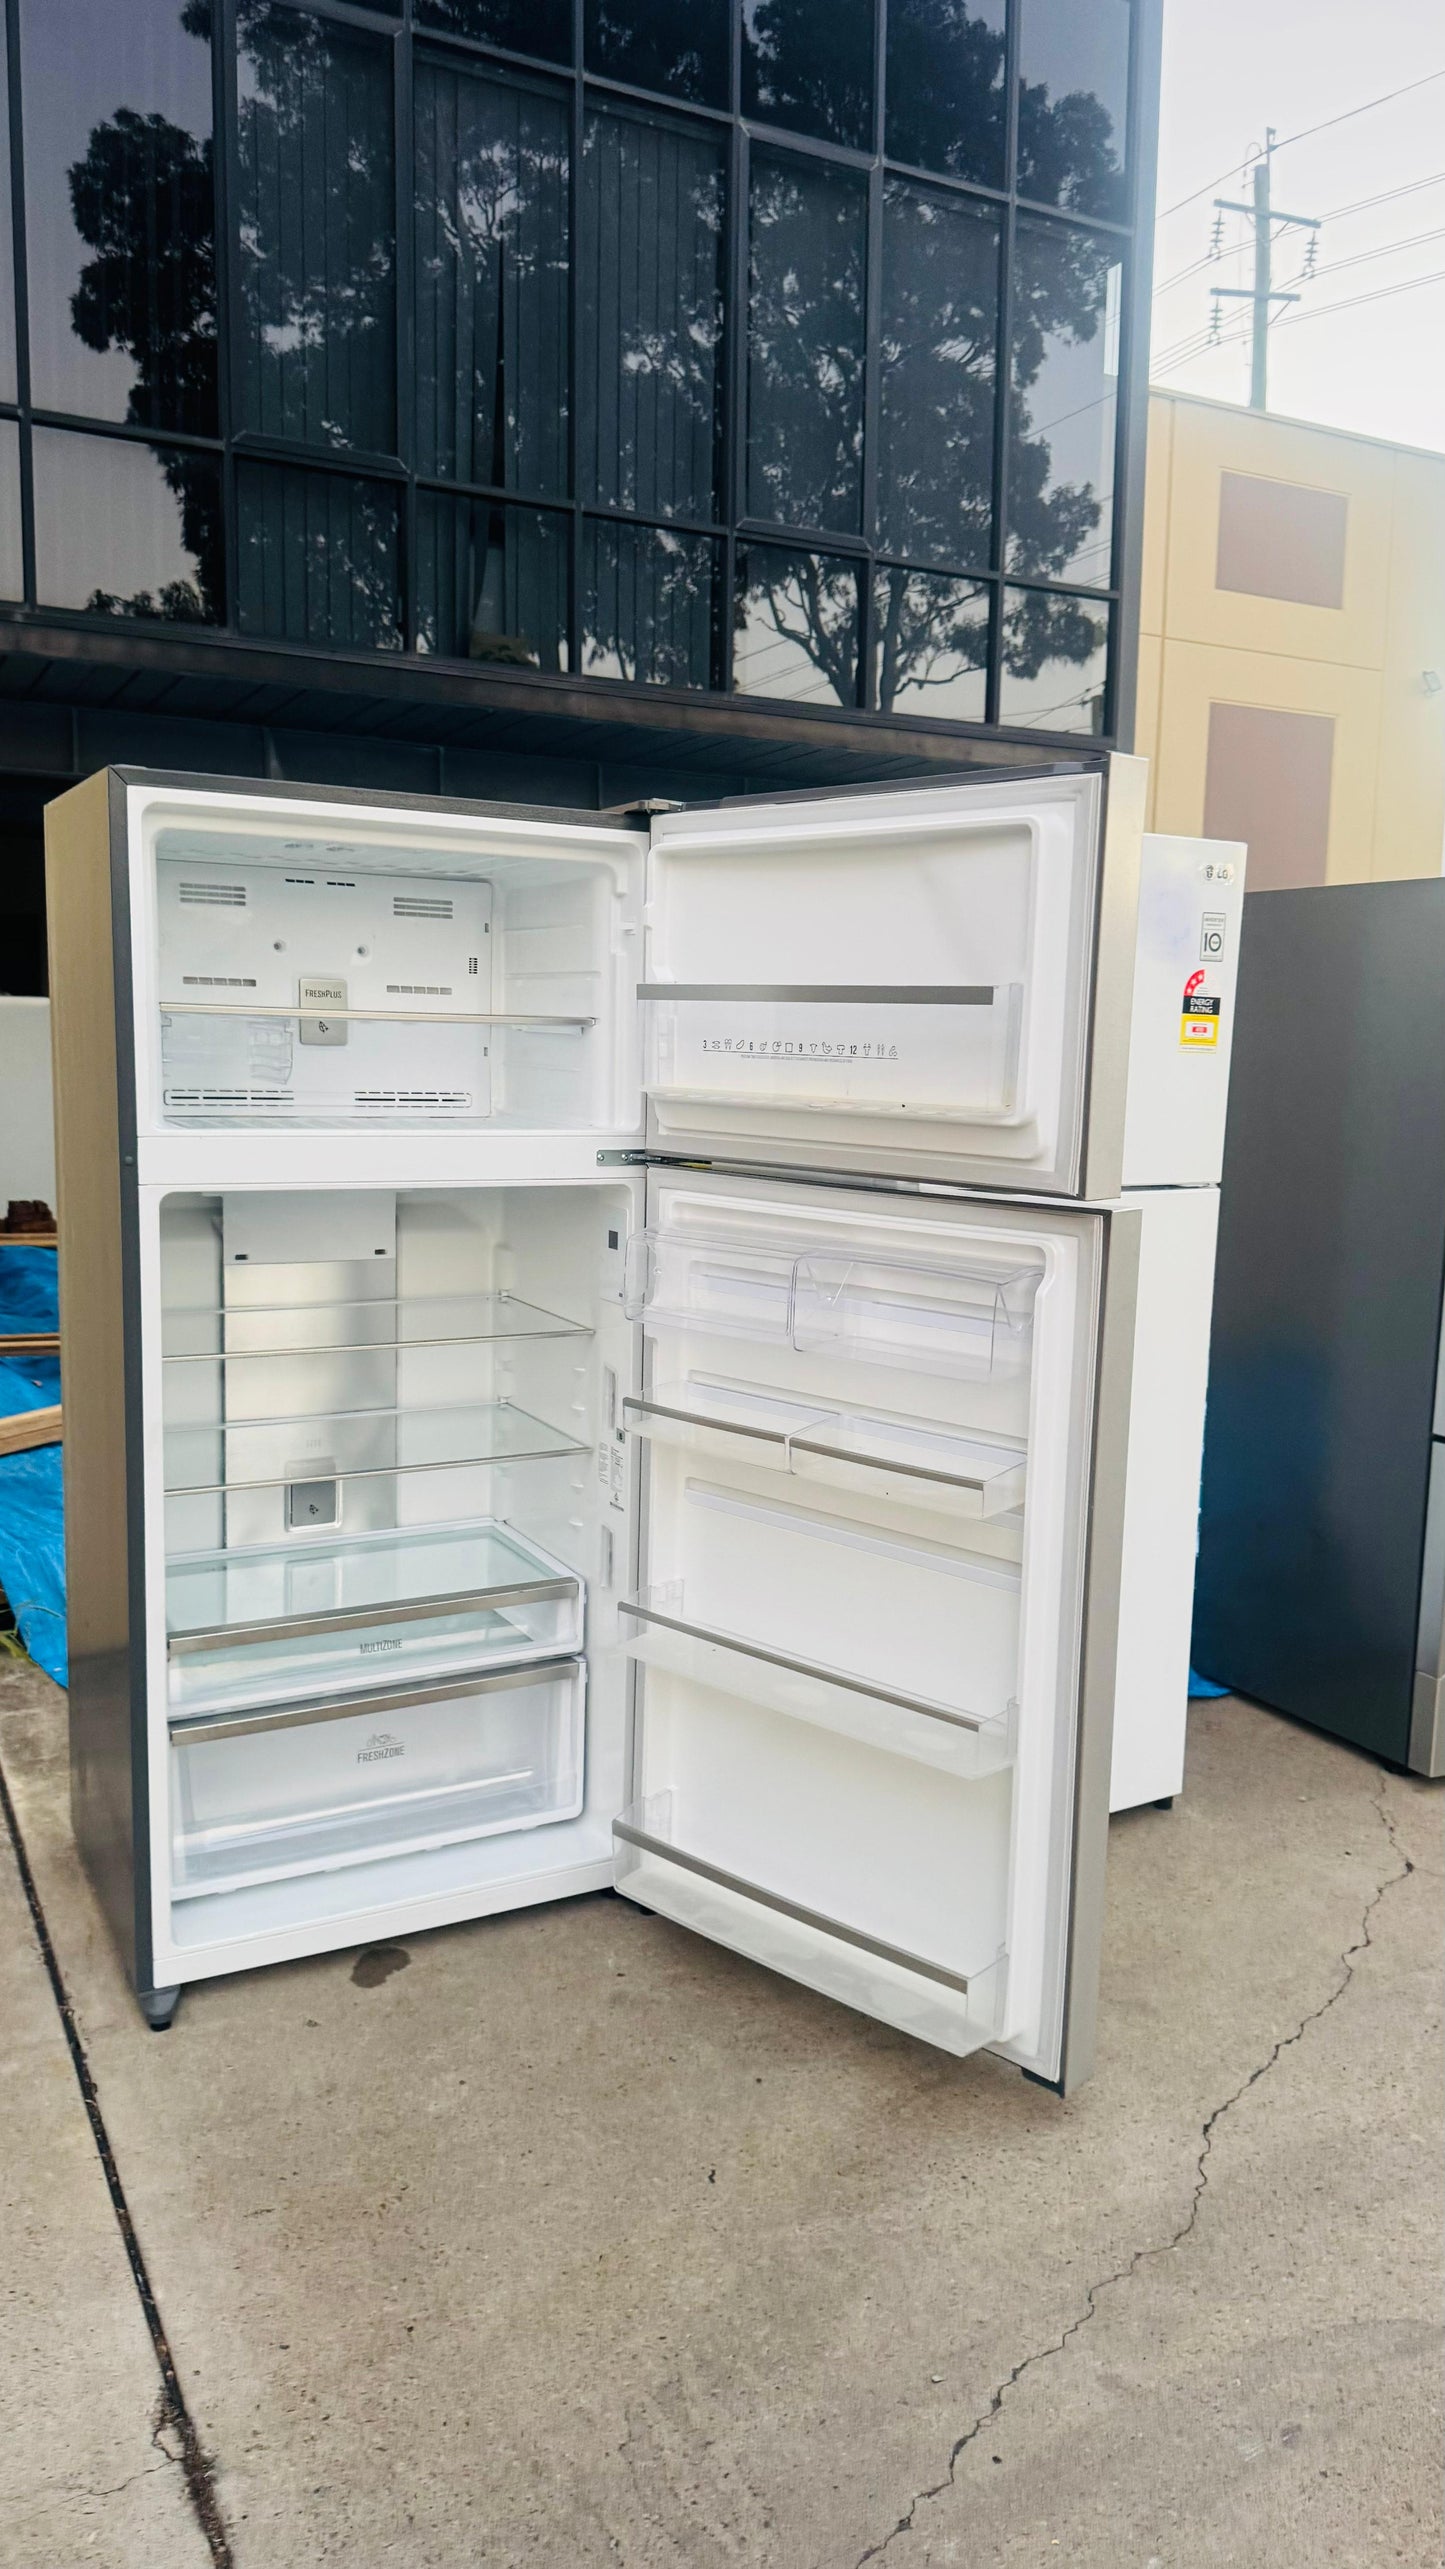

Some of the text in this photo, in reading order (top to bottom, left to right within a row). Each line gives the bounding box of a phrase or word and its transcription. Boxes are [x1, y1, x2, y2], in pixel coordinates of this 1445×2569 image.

[1204, 932, 1222, 952] 10
[1190, 998, 1214, 1006] ENERGY
[1190, 1005, 1213, 1014] RATING
[703, 1040, 858, 1055] 3 6 9 12
[360, 1638, 402, 1655] MULTIZONE
[357, 1745, 405, 1764] FRESHZONE
